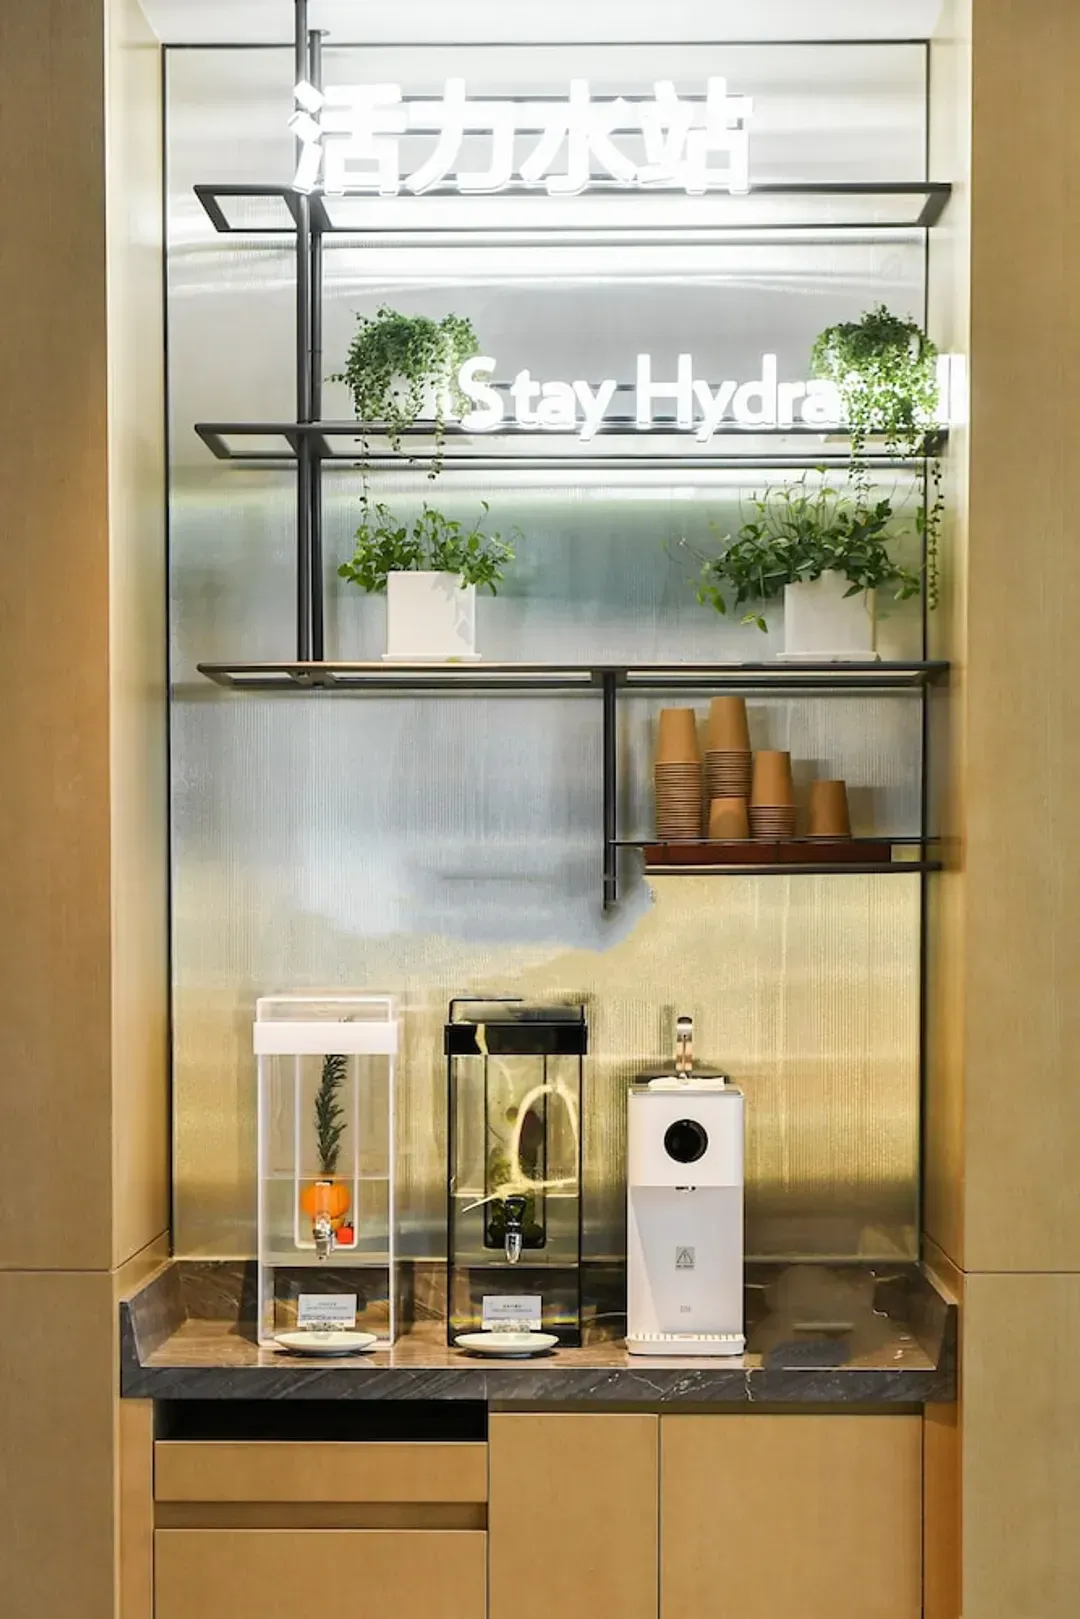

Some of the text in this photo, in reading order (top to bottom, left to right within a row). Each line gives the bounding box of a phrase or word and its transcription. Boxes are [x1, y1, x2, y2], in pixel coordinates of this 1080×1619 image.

[288, 76, 755, 196] 活力水站
[457, 352, 952, 441] Stay Hydra
